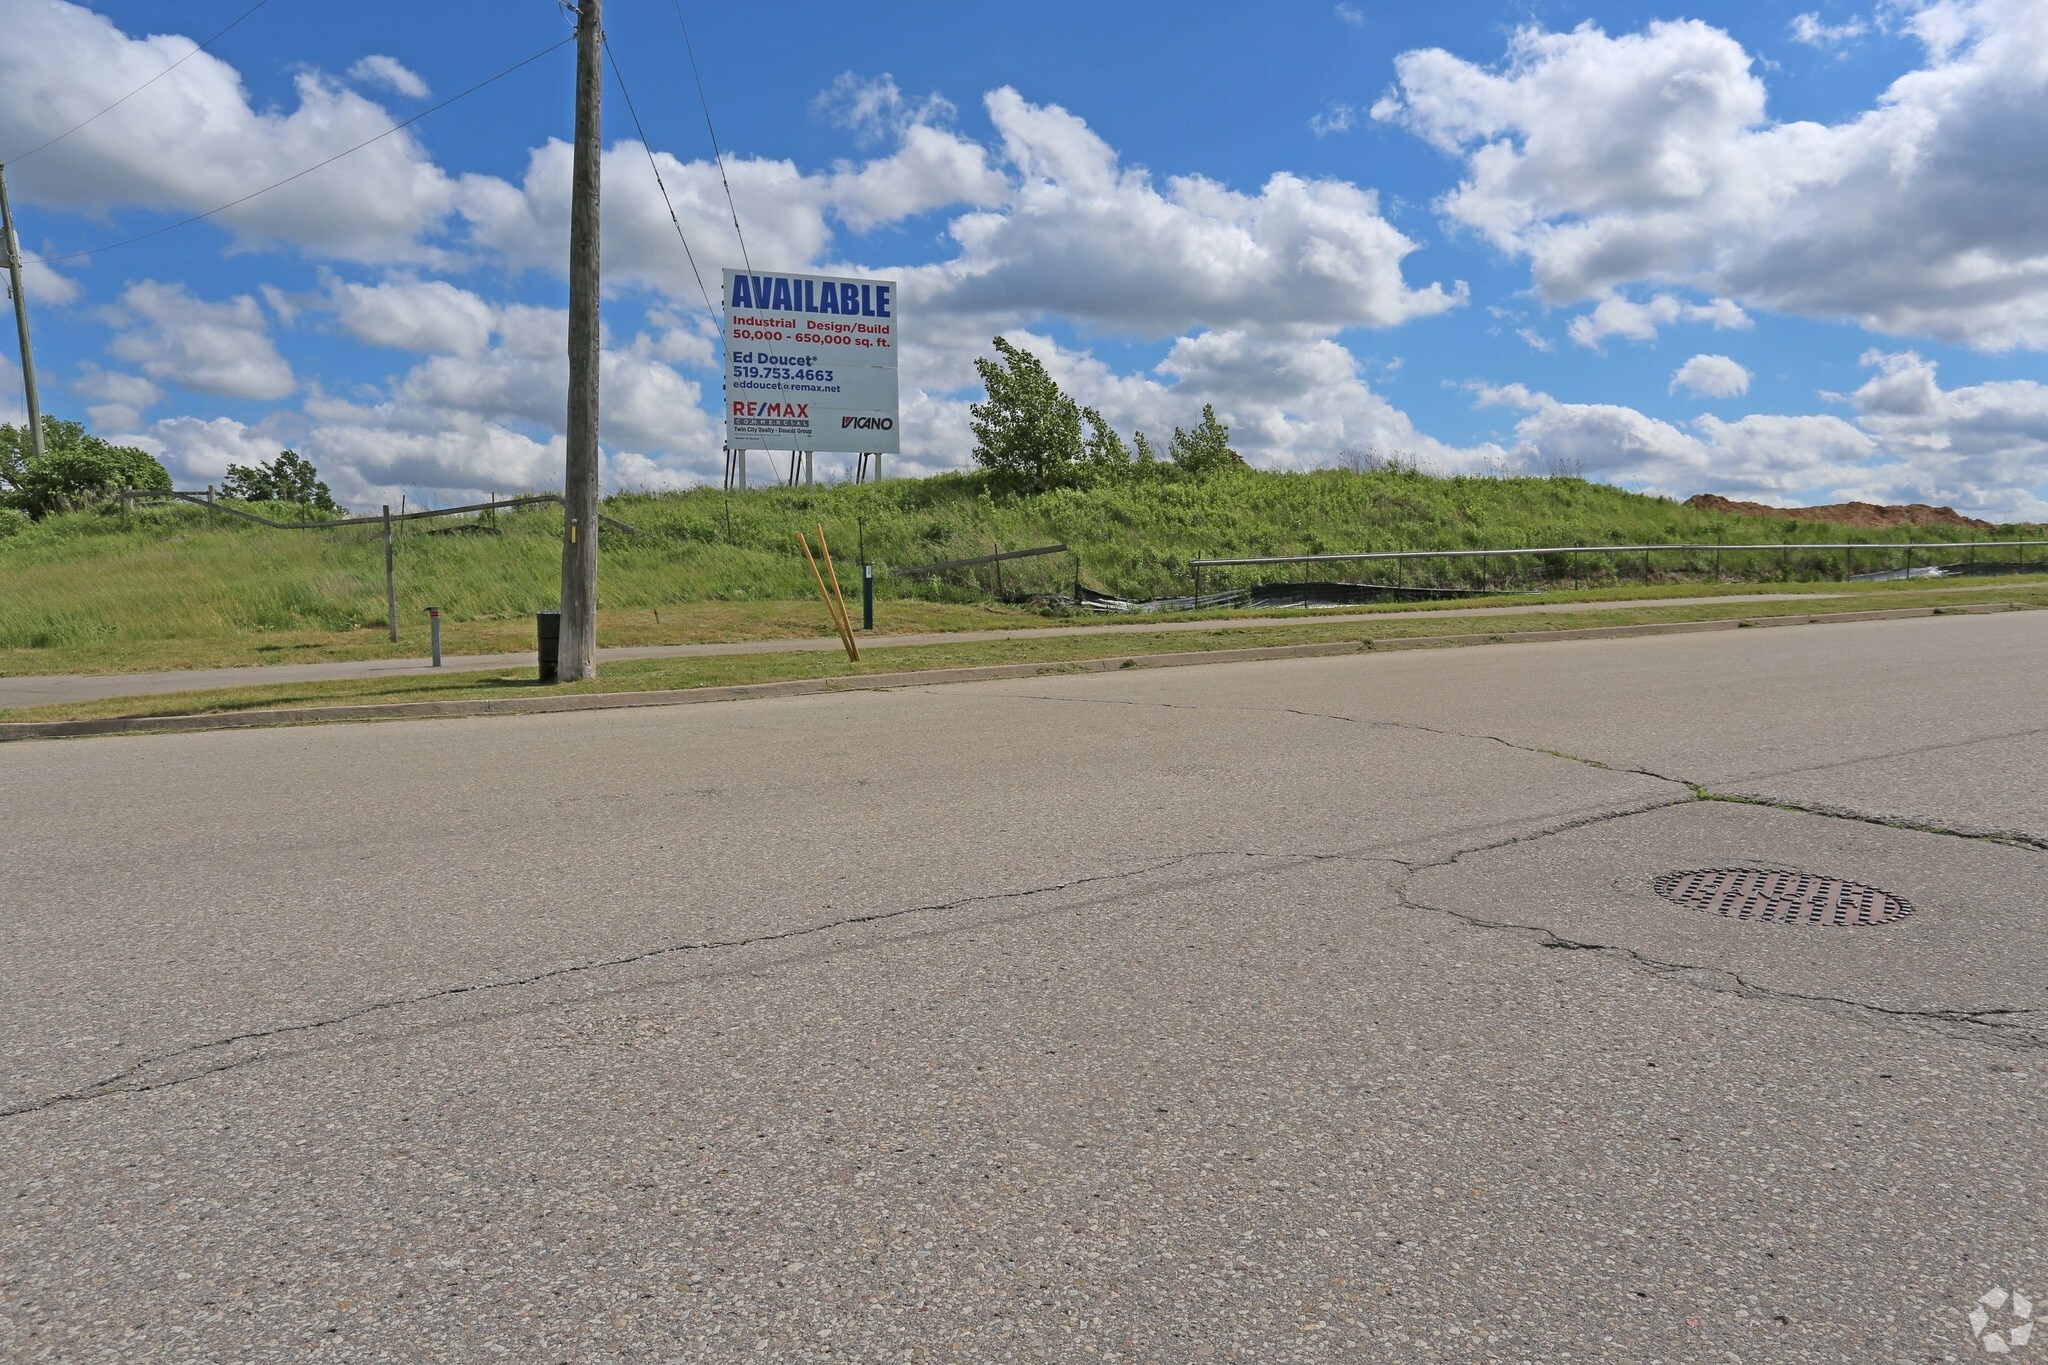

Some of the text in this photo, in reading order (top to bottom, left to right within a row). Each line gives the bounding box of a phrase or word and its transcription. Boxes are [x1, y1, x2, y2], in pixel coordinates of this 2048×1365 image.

[731, 274, 891, 318] AVAILABLE
[733, 315, 890, 335] Industrial Design/Build
[732, 329, 783, 341] 50,000
[795, 333, 851, 345] 650,000
[855, 338, 873, 348] sq.
[876, 337, 891, 348] ft.
[733, 351, 753, 364] Ed
[733, 366, 834, 382] 519.753.4663
[733, 380, 841, 393] eddoucet@remax.net
[733, 401, 809, 418] RE/MAX
[735, 418, 808, 427] COMMERCIAL
[841, 416, 893, 431] VICANO
